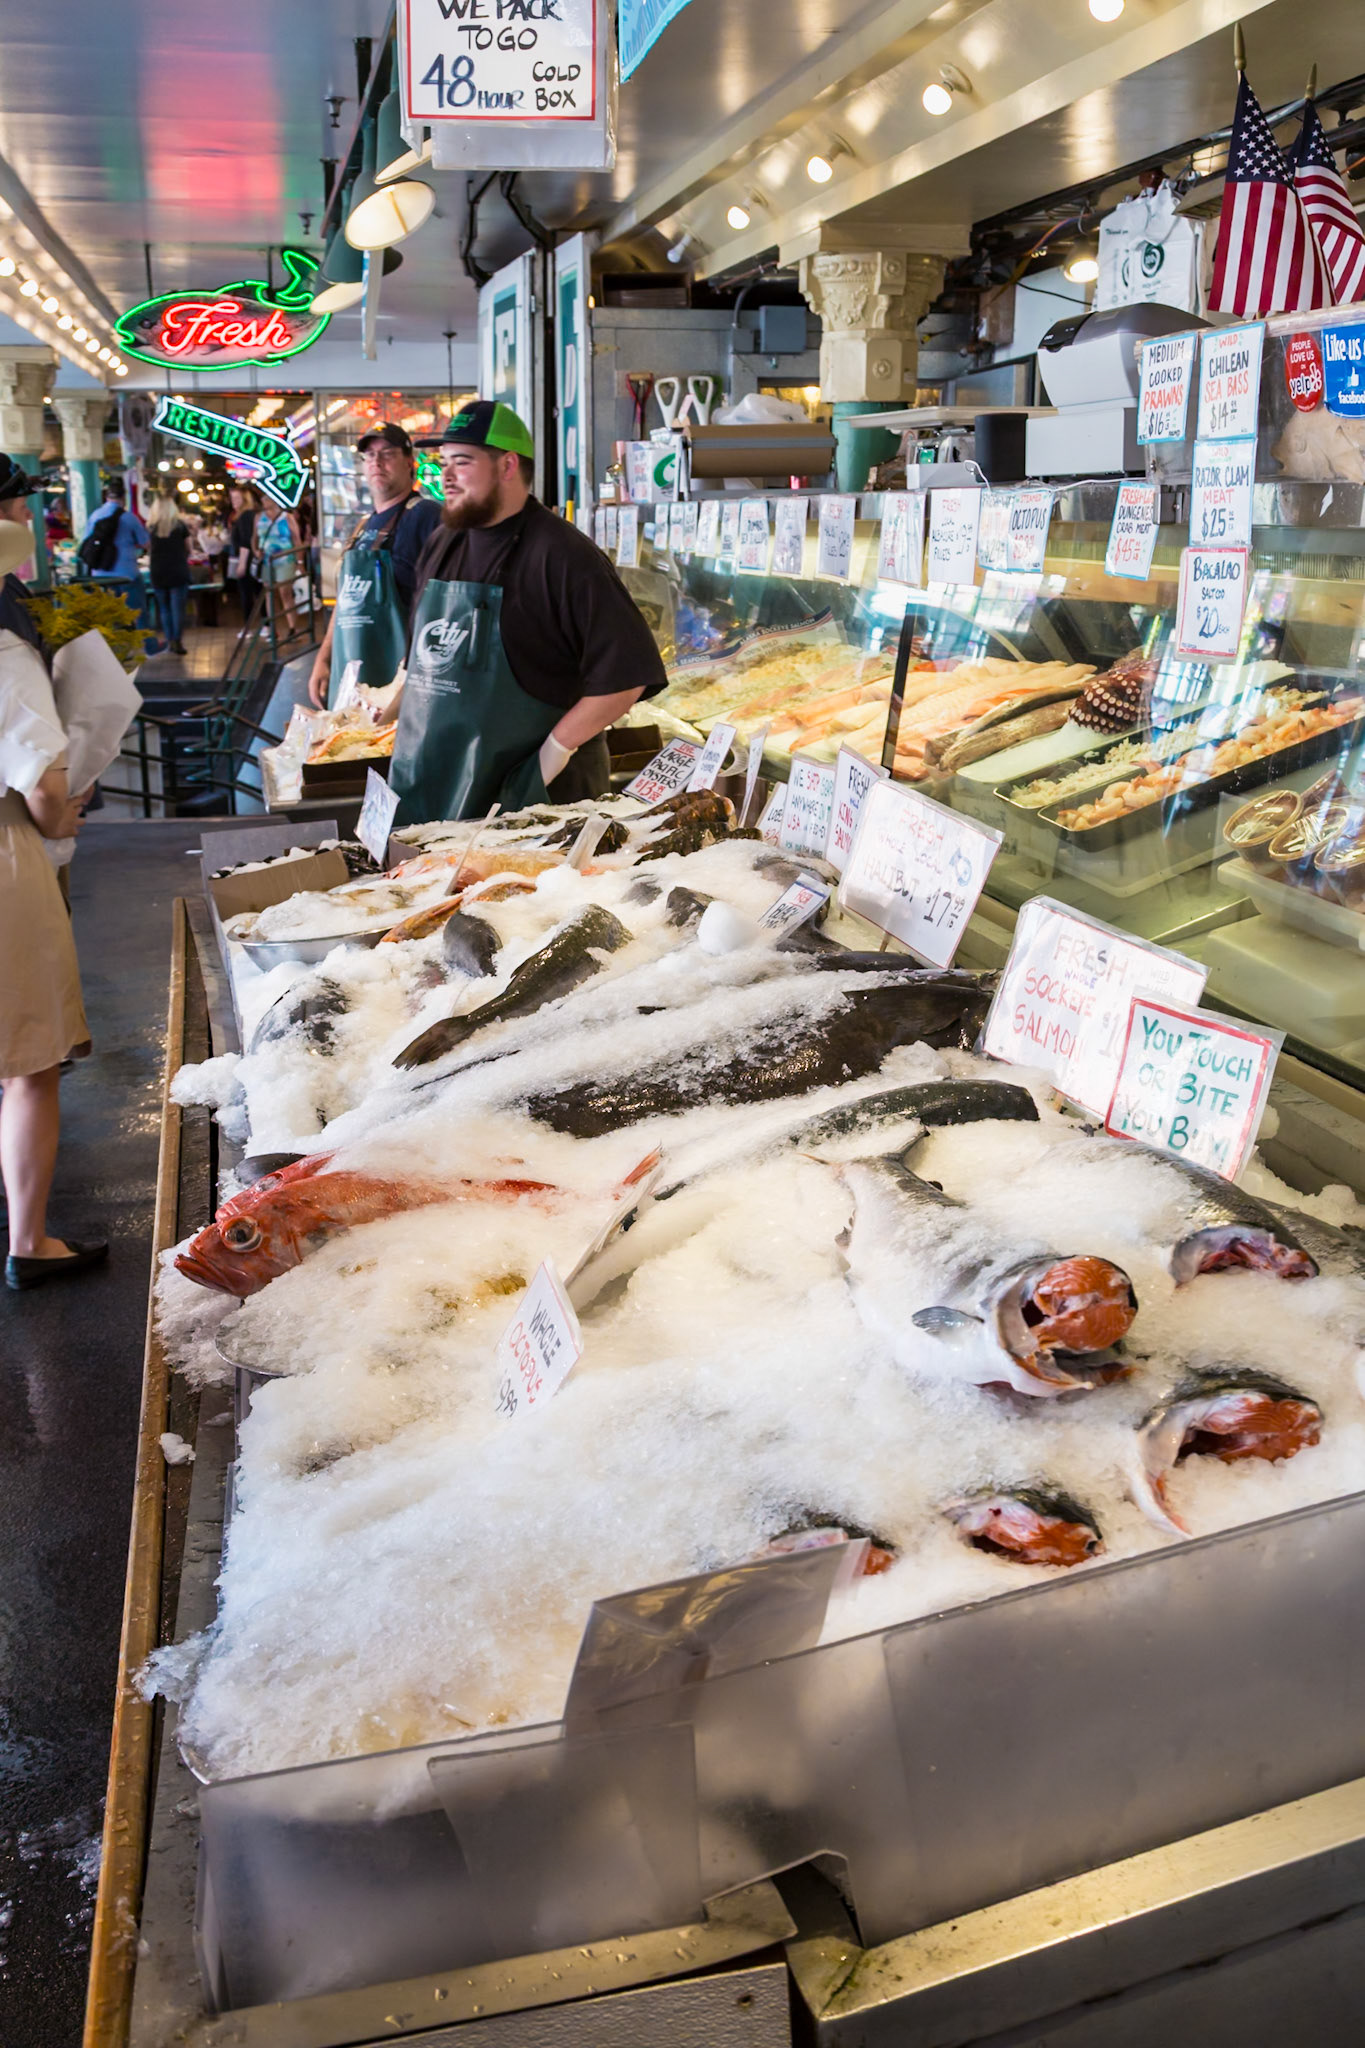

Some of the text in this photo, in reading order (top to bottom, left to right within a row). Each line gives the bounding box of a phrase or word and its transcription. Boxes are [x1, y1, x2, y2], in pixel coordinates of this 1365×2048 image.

[438, 0, 564, 21] WE PACK
[458, 25, 538, 52] TO GO
[420, 53, 526, 110] 48 HOUR
[532, 61, 581, 82] COLD
[535, 87, 576, 111] BOX
[160, 301, 293, 352] Fresh
[1149, 341, 1185, 367] MEDIUM
[1219, 334, 1238, 348] WILD
[1292, 340, 1311, 351] PEOPLE
[1325, 333, 1361, 361] Like us
[1209, 350, 1250, 378] CHILEAN
[1290, 350, 1315, 363] LOVE US
[1149, 366, 1183, 388] COOKED
[1205, 370, 1249, 403] SEA BASS
[1289, 373, 1312, 399] yelp
[1143, 384, 1184, 412] PRAWNS
[1211, 402, 1228, 432] $14
[167, 404, 300, 490] RESTROOMS
[1195, 465, 1249, 488] RAZOR CLAM
[1203, 488, 1235, 505] MEAT
[1012, 507, 1047, 530] OCTOPUS
[1118, 505, 1154, 521] DUNGENES
[1202, 508, 1226, 541] $25
[1116, 522, 1152, 534] CRAB MEAT
[1114, 537, 1134, 565] $45
[1193, 556, 1240, 581] BACALAO
[1202, 587, 1215, 600] SALT
[1197, 606, 1219, 638] $20
[650, 759, 685, 779] PACIFIC
[660, 748, 696, 768] LARGE
[635, 778, 657, 796] $13
[642, 769, 677, 789] OYSTERS
[848, 765, 870, 799] FRESH
[864, 856, 920, 903] HALIBUT
[1054, 934, 1129, 986] FRESH
[1024, 967, 1096, 1017] SOCKEYE
[1065, 969, 1097, 989] WHOLE
[1012, 1003, 1085, 1062] SALMON
[1143, 1015, 1253, 1082] YOU TOUCH
[1138, 1063, 1239, 1117] OR BITE
[1121, 1094, 1163, 1136] YOU
[529, 1299, 562, 1368] WHOLE
[509, 1321, 543, 1404] OCTOPUS
